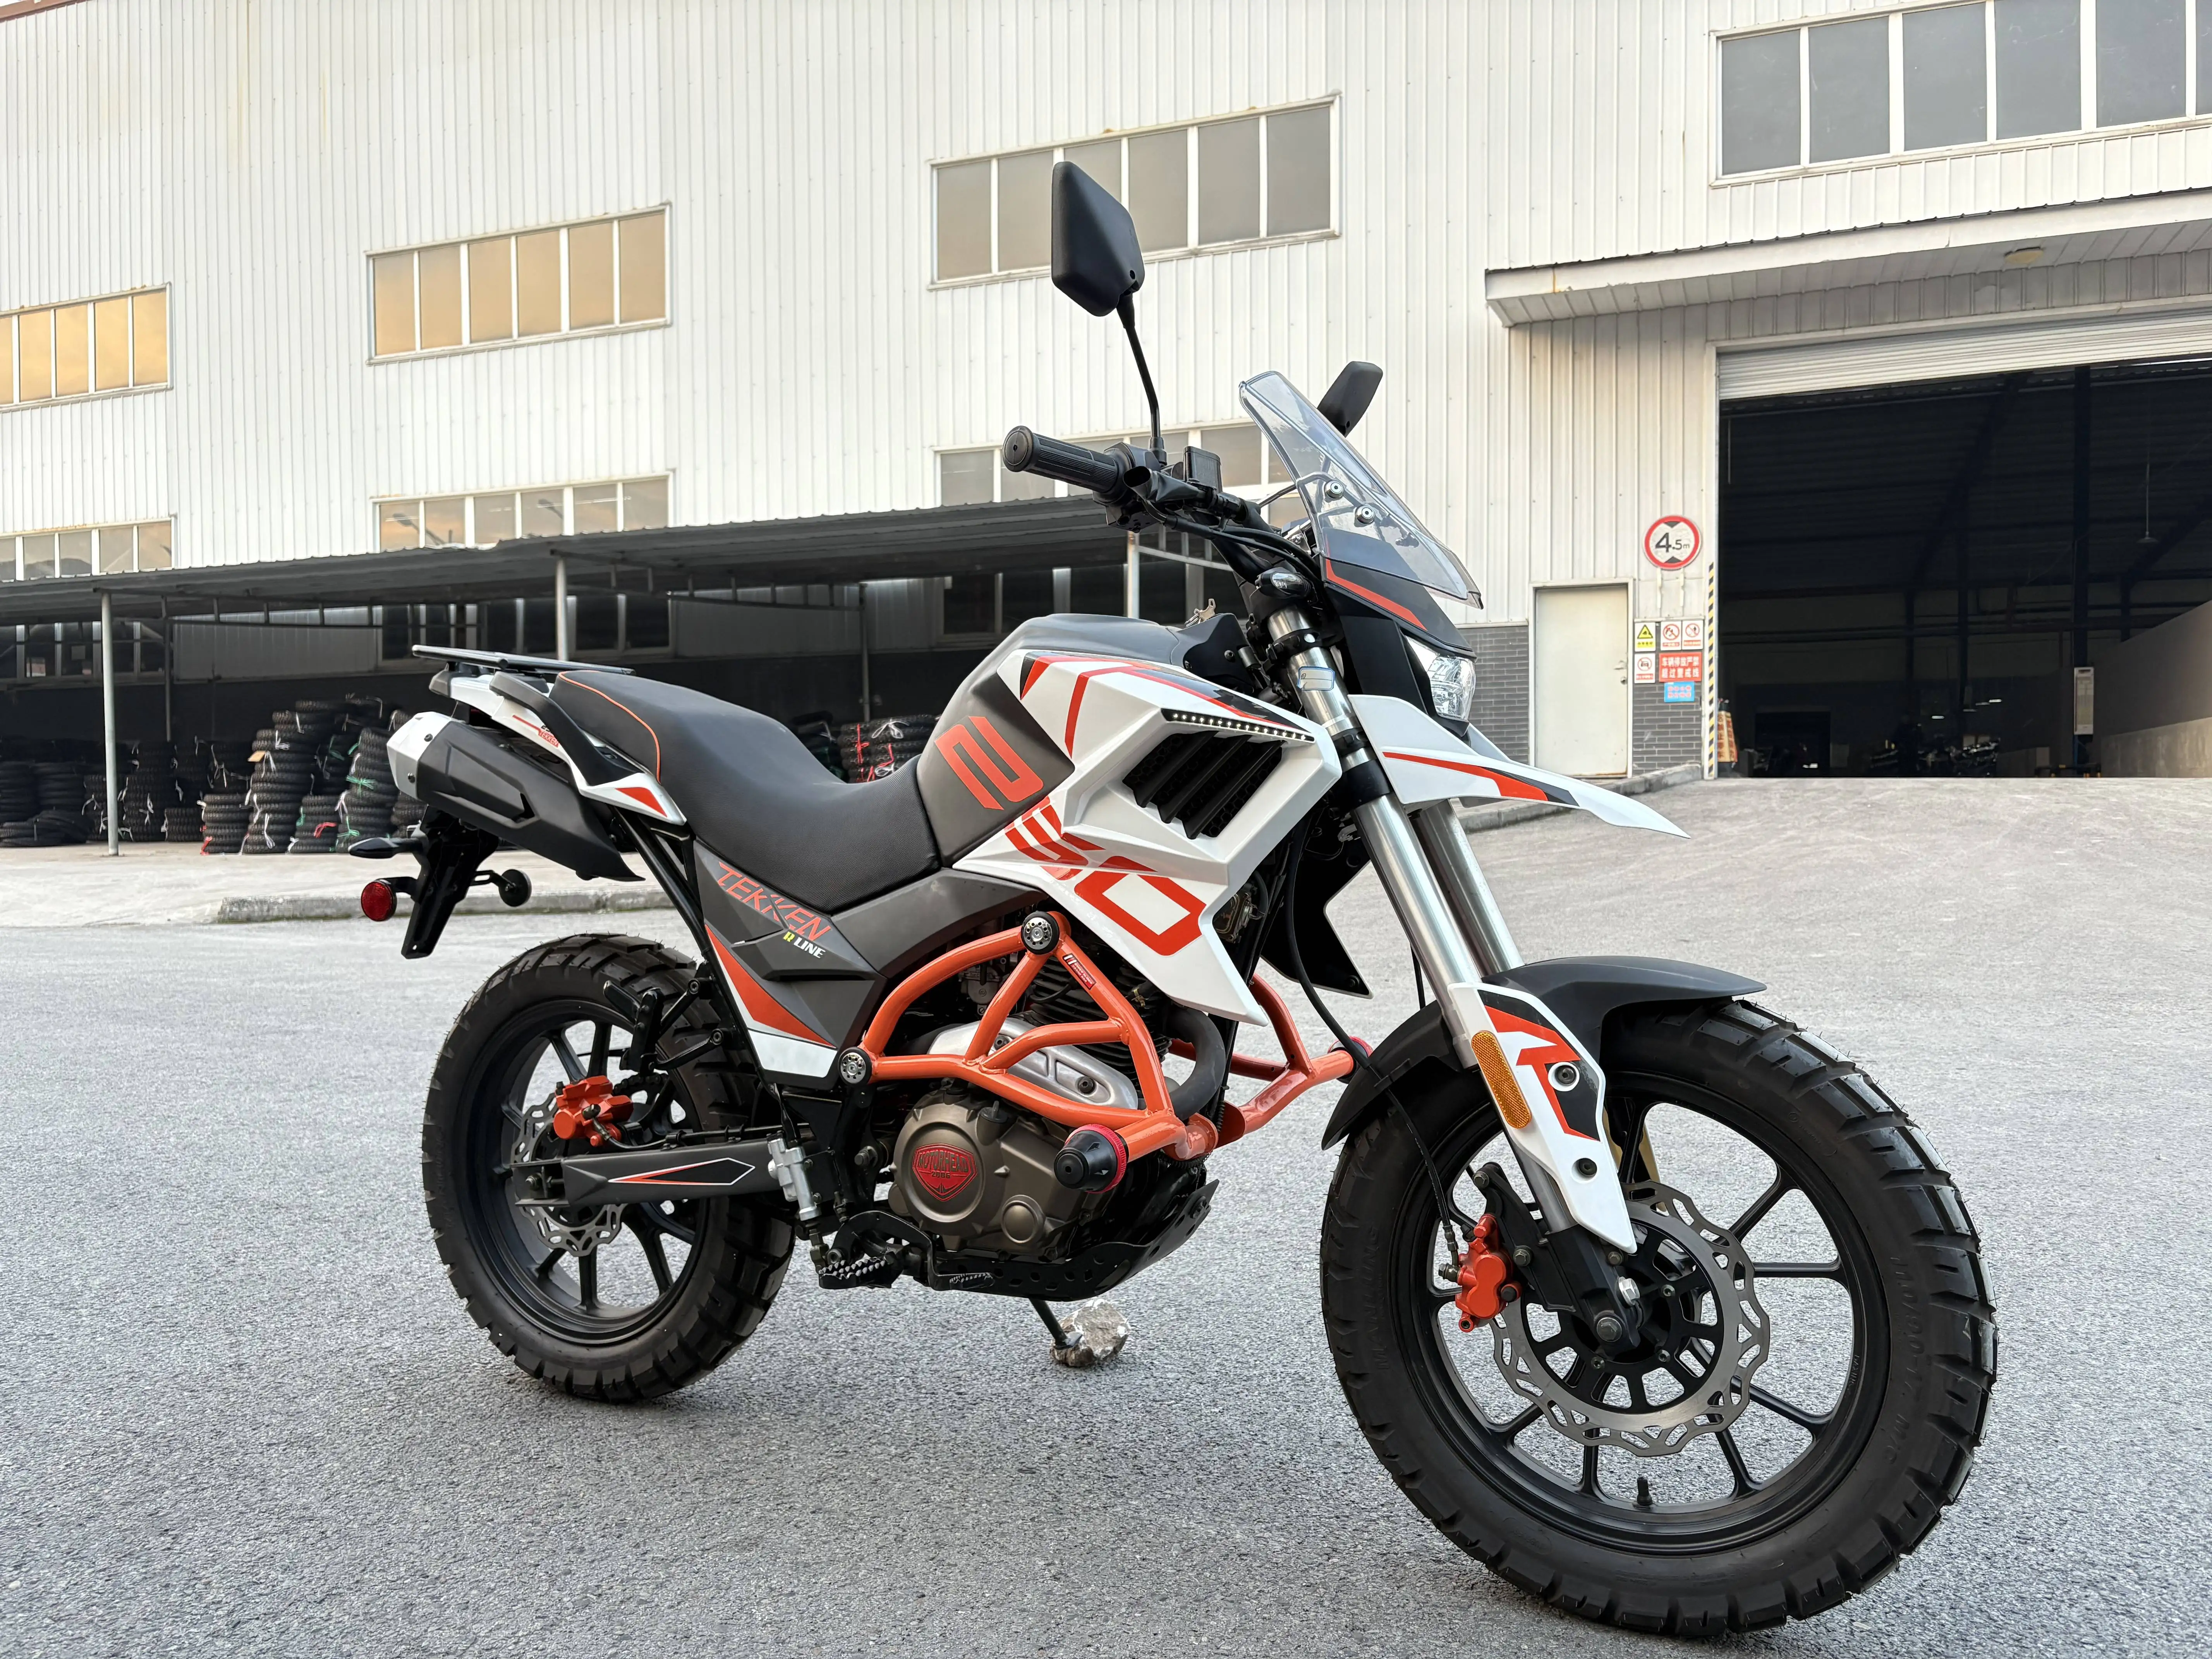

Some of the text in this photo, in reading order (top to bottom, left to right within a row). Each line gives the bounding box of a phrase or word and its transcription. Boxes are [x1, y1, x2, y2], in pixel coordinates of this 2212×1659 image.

[717, 861, 831, 941] TEKKEN
[783, 931, 826, 958] R LINE
